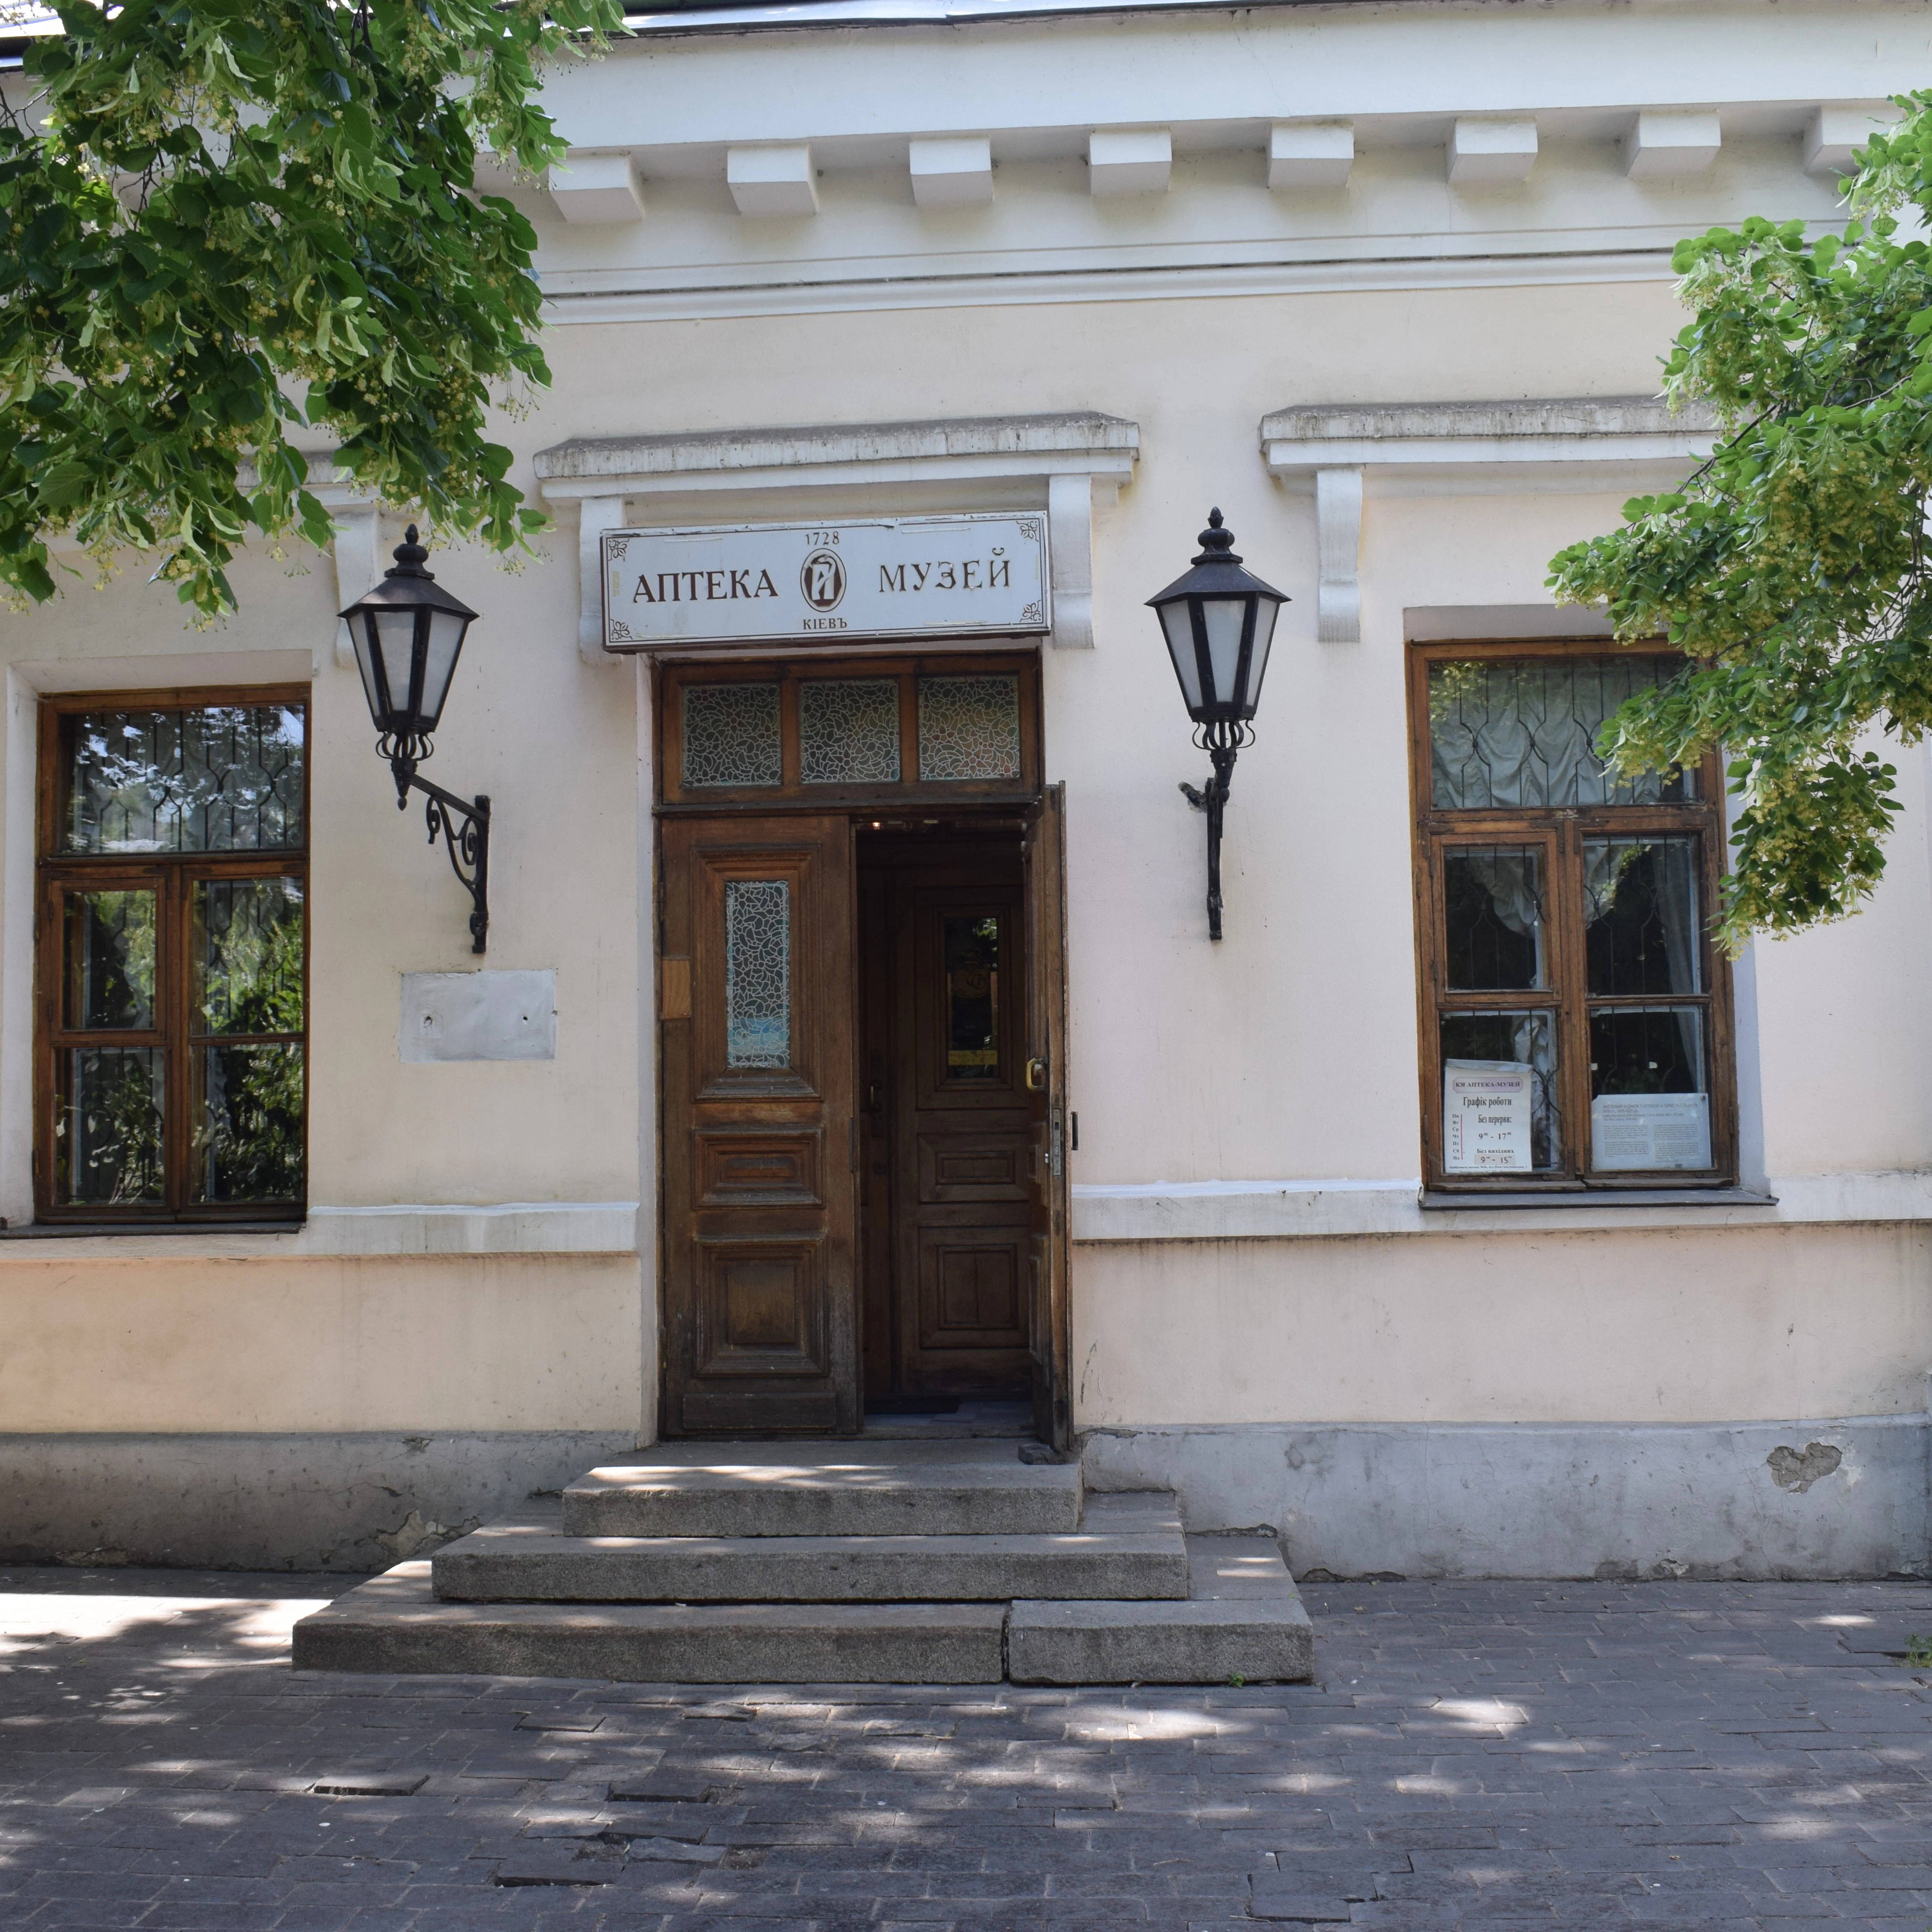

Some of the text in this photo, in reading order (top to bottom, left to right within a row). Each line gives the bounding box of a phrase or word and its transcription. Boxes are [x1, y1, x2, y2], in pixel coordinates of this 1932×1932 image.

[805, 531, 840, 546] 1728
[633, 547, 1010, 604] АПТЕКА МУЗЕЙ
[803, 617, 848, 630] КІЕВЪ
[1463, 1096, 1512, 1108] Графік роботи
[1478, 1114, 1487, 1123] Без
